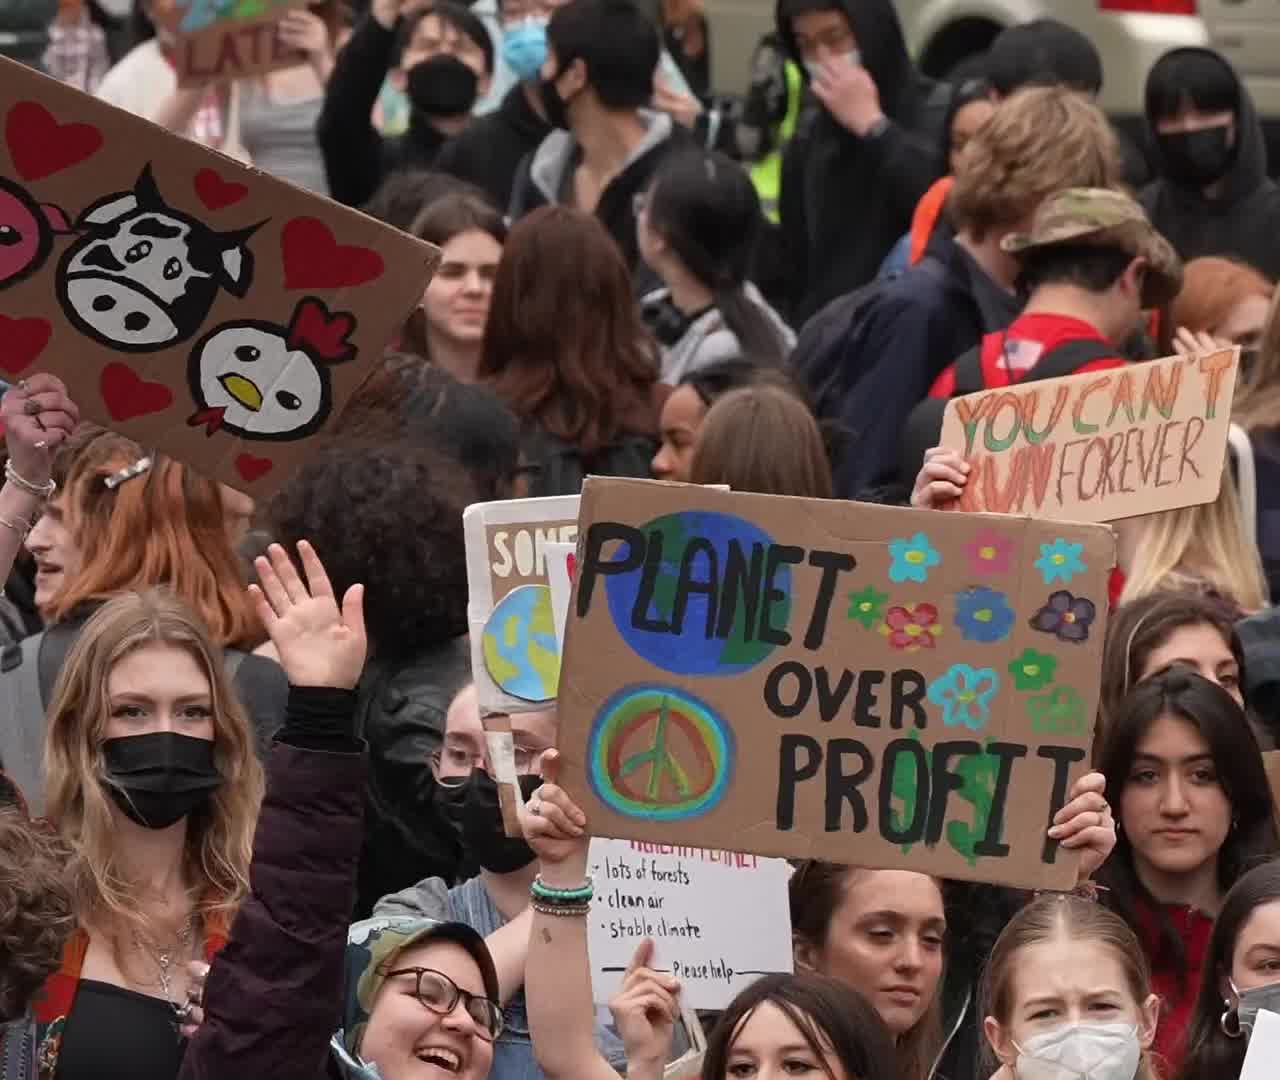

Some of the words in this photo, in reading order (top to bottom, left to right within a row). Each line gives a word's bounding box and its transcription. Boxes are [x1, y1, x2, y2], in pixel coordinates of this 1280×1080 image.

[954, 385, 1070, 457] YOU
[959, 442, 1057, 514] RUN
[1055, 416, 1205, 508] FOREVER
[575, 521, 857, 651] PLANET
[763, 659, 927, 732] OVER
[775, 733, 1087, 865] PROFIT
[605, 856, 632, 880] lots
[636, 857, 648, 880] of
[651, 860, 691, 886] forests
[607, 888, 645, 909] clean
[647, 896, 664, 910] air
[657, 917, 702, 939] climate
[673, 960, 709, 979] Please
[709, 958, 734, 985] help
